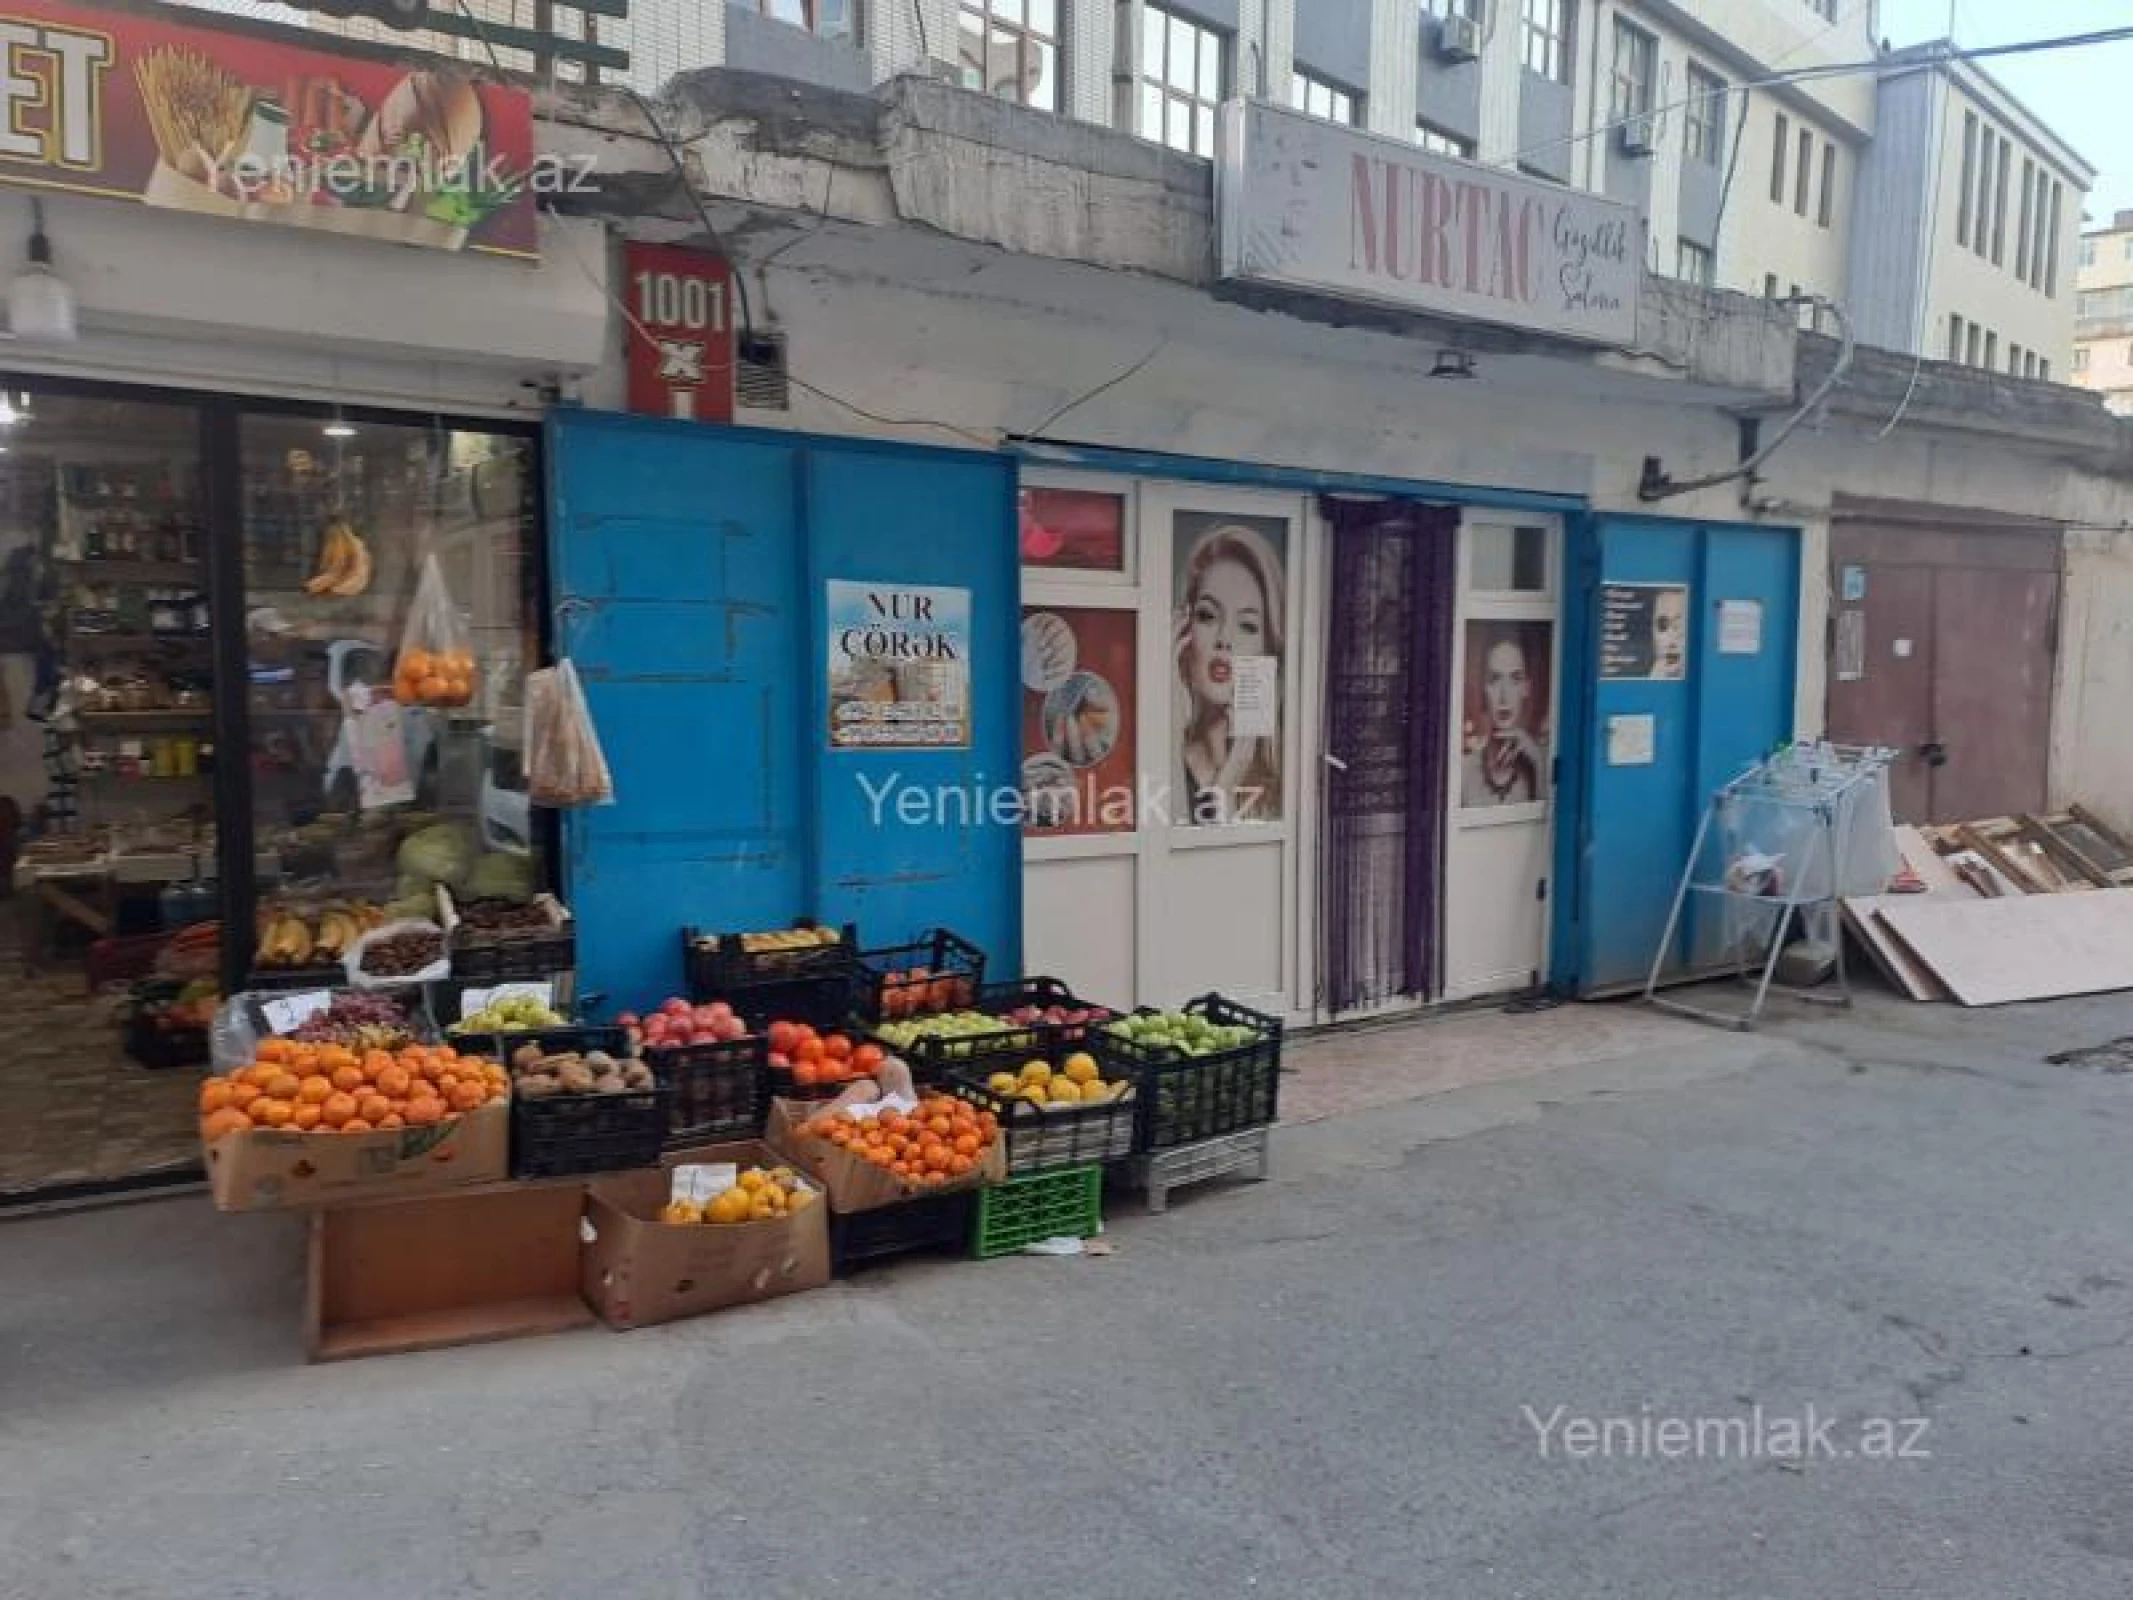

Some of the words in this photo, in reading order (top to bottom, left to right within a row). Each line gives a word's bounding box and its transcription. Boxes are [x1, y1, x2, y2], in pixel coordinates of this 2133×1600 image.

[1349, 152, 1545, 303] NURTAC
[635, 271, 725, 331] 1001
[868, 591, 933, 621] NUR
